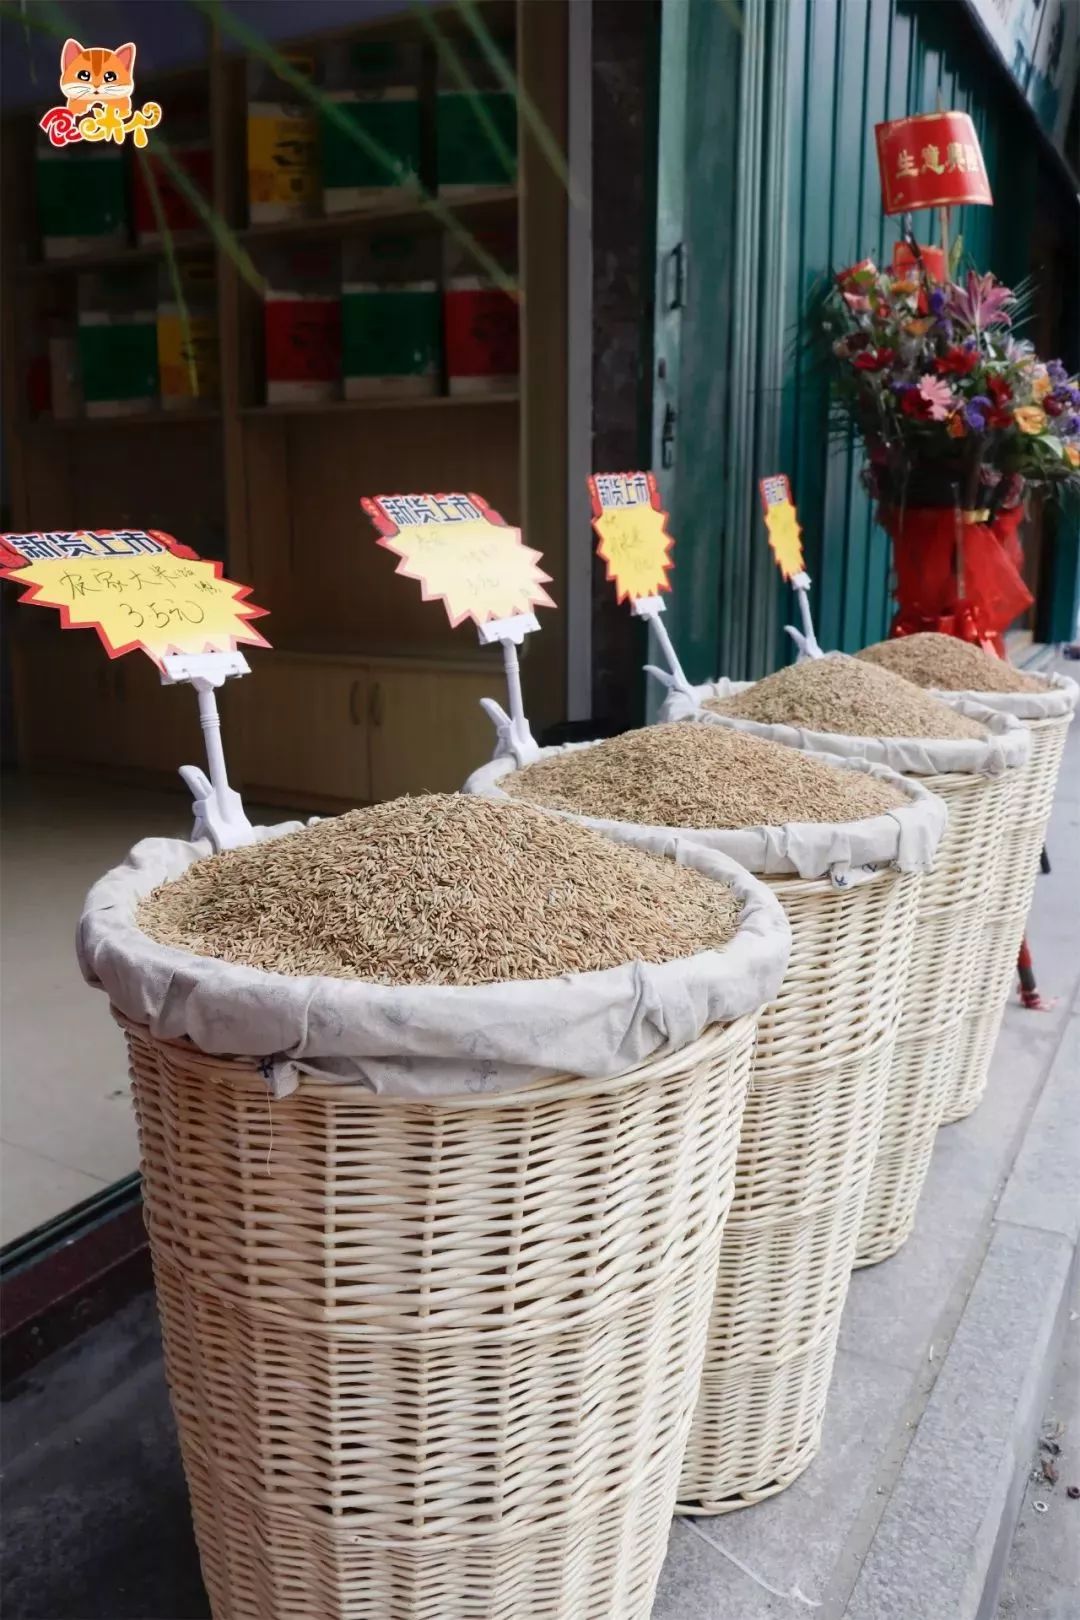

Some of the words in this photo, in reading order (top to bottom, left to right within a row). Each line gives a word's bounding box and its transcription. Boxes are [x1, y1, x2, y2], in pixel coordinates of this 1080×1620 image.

[381, 496, 482, 525] 新货上市
[7, 531, 165, 559] 新货上市
